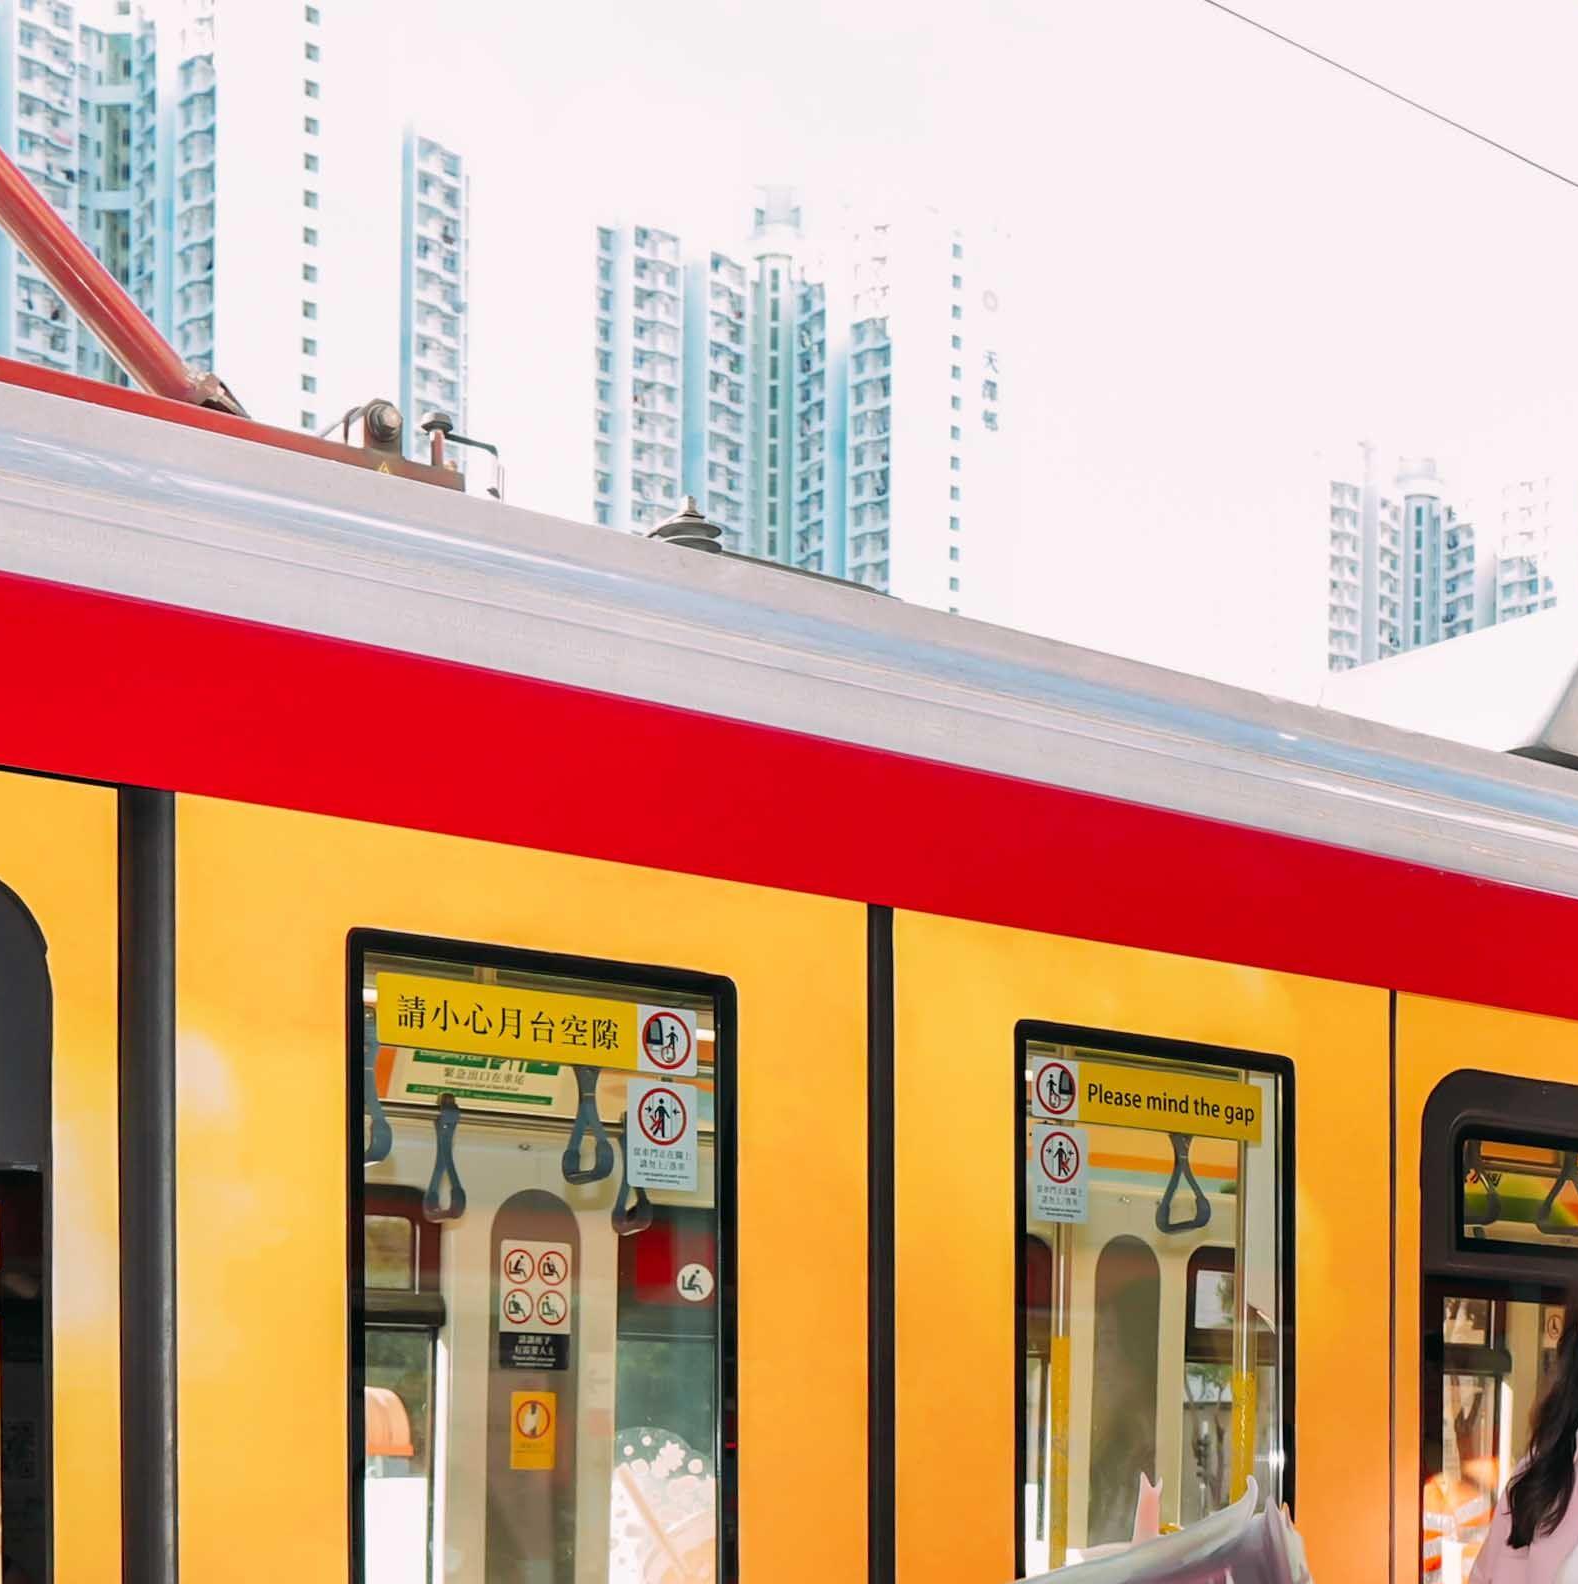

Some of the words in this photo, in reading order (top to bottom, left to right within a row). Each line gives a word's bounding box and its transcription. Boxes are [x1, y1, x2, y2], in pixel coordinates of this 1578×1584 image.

[396, 994, 620, 1050] 請小心月台空隙
[1087, 1083, 1142, 1109] Please
[1146, 1092, 1189, 1115] mind
[1194, 1097, 1220, 1118] the
[1224, 1105, 1255, 1127] gap
